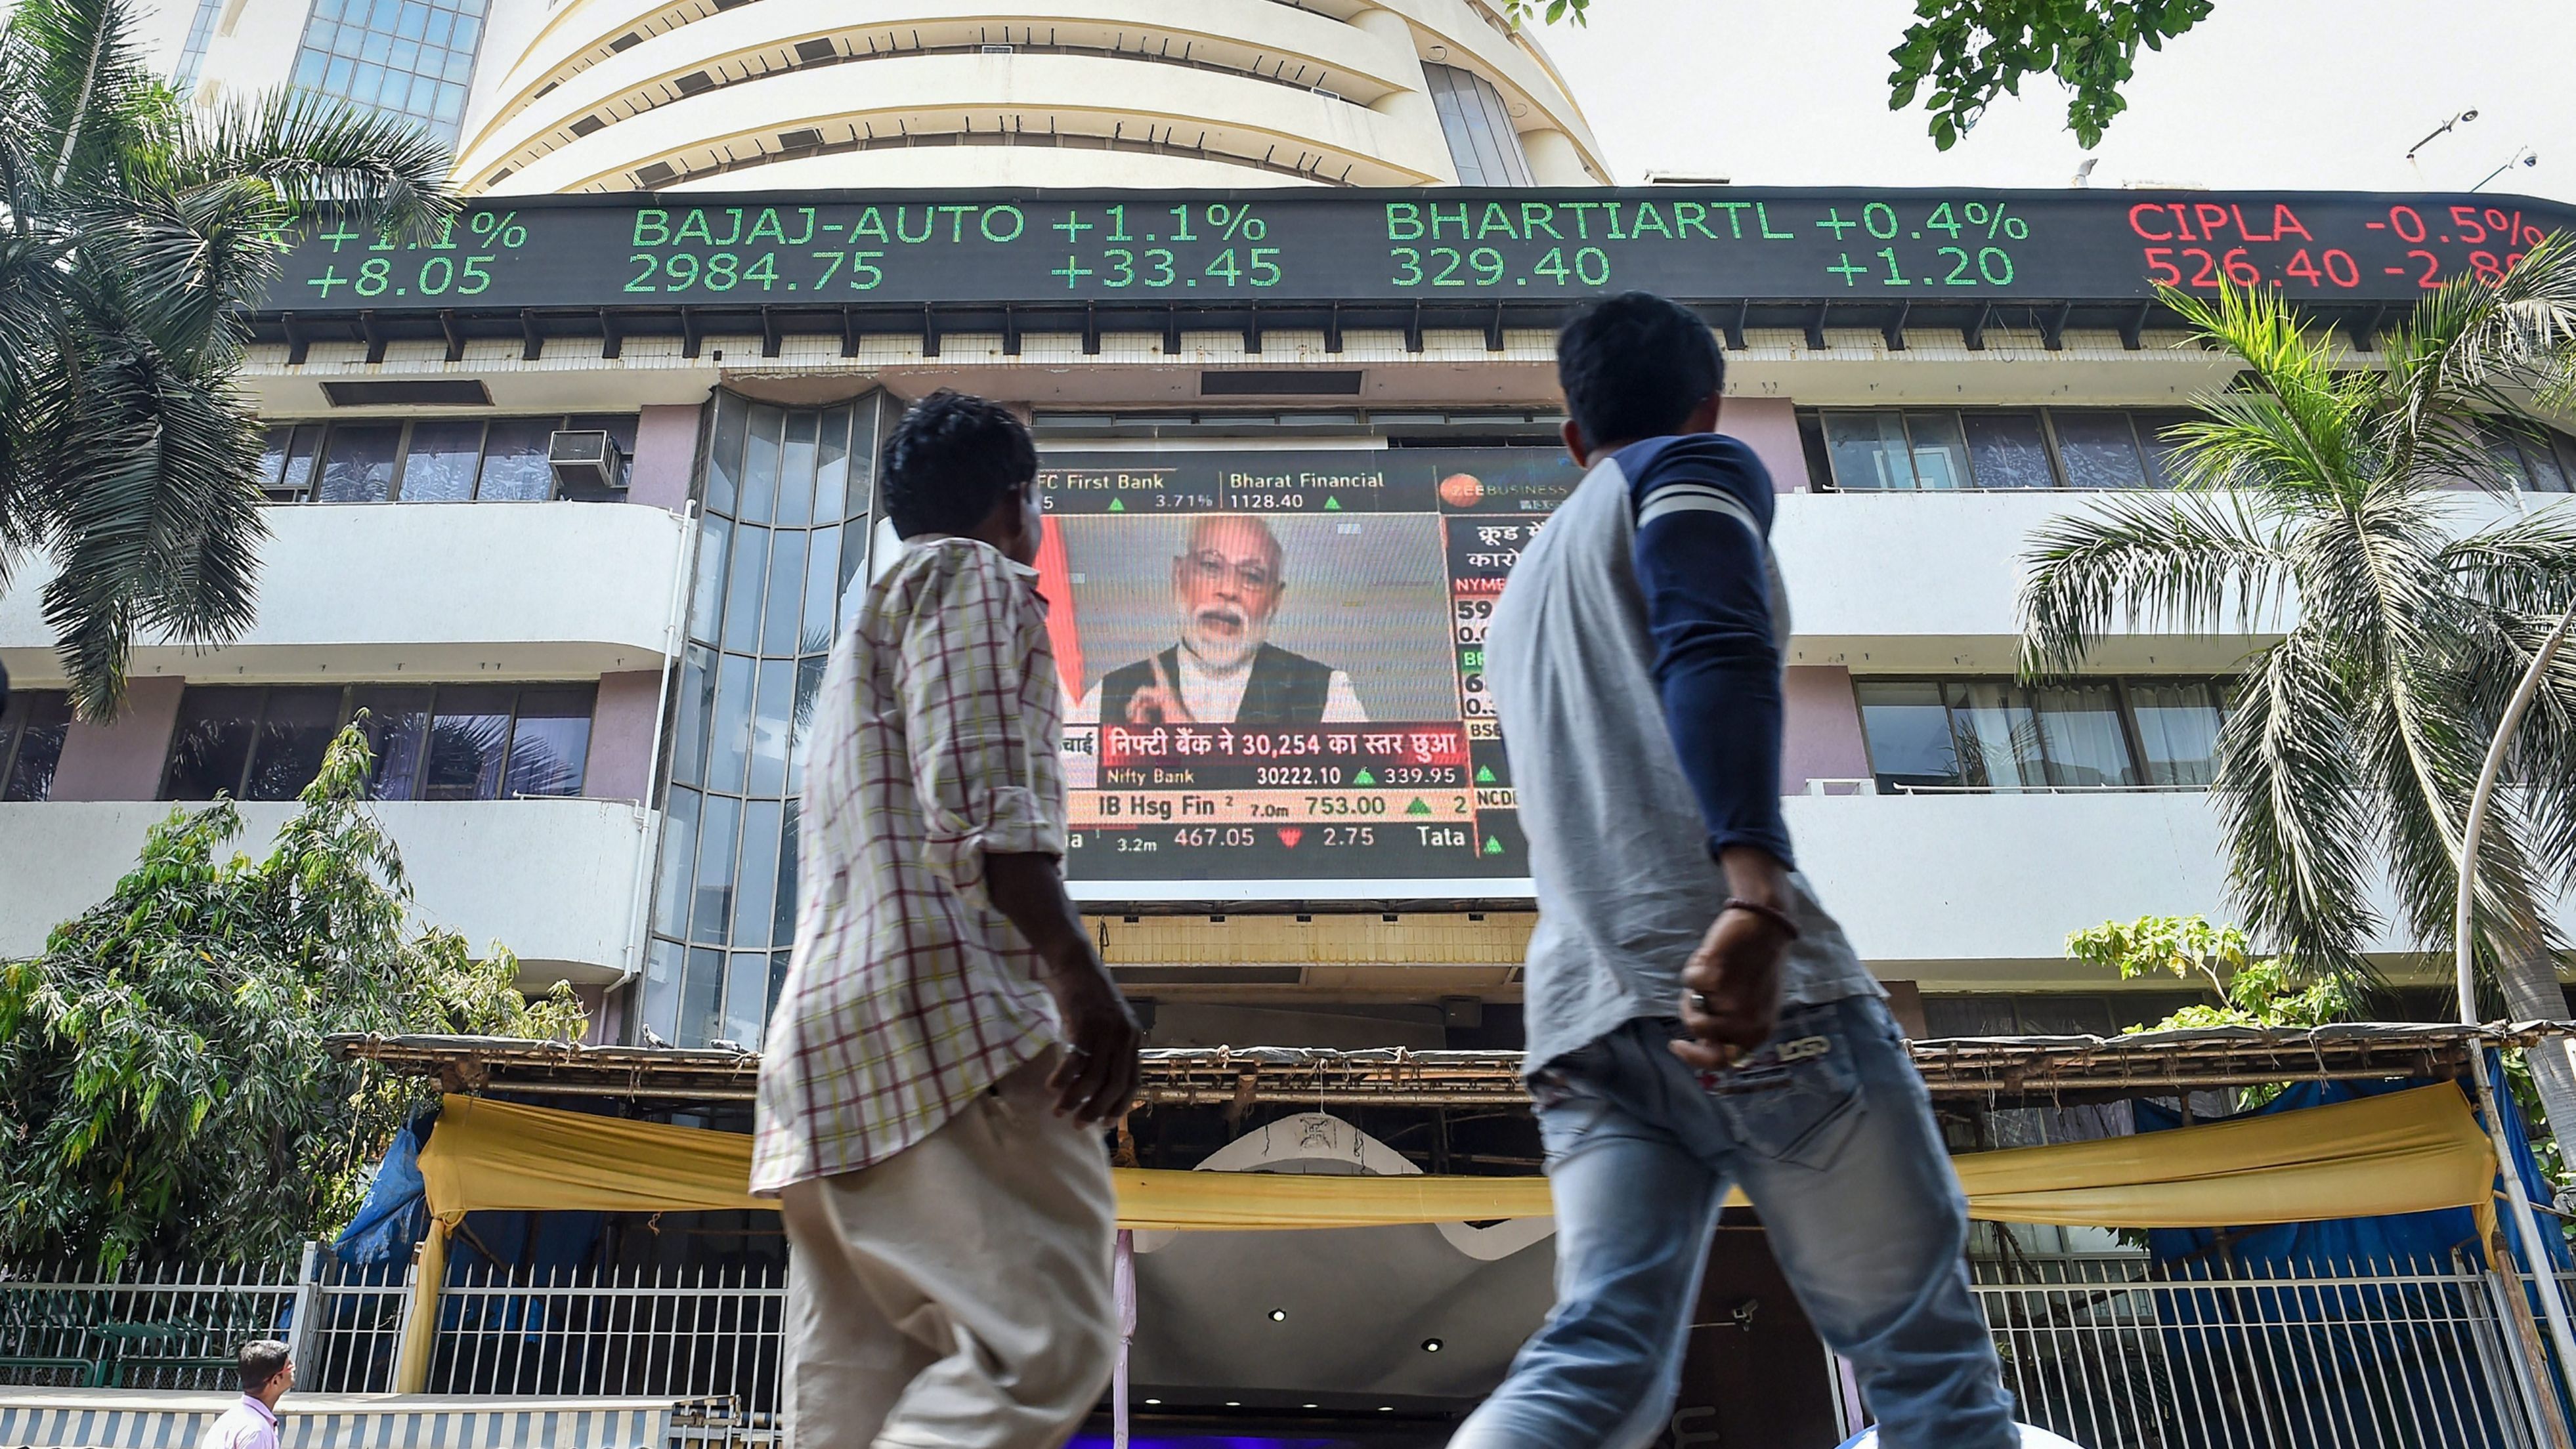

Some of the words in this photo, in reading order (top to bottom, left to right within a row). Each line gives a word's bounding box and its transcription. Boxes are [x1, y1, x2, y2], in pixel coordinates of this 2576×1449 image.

[632, 205, 1024, 247] BAJAJ-AUTO
[1052, 204, 1267, 243] +1.1%
[1386, 201, 1794, 240] BHARTIARTL
[1816, 202, 2029, 240] +0.4%
[2129, 203, 2312, 242] CIPLA
[2366, 205, 2544, 246] -0.5%
[307, 255, 495, 297] +8.05
[624, 251, 884, 292] 2984.75
[1051, 247, 1281, 289] +33.45
[1390, 247, 1610, 286] 329.40
[1826, 246, 2014, 285] +1.20
[2144, 247, 2360, 287] 526.40
[1067, 474, 1109, 489] First
[1118, 473, 1163, 489] Bank
[1230, 472, 1291, 488] Bharat
[1300, 472, 1384, 488] Financial
[1155, 494, 1213, 507] 3.71%
[1231, 494, 1303, 509] 1128.40
[1060, 732, 1093, 755] चाई
[1218, 726, 1234, 755] ने
[1242, 734, 1321, 758] 30,254
[1327, 734, 1358, 754] का
[1107, 768, 1146, 786] Nifty
[1154, 768, 1194, 784] Bank
[1257, 766, 1341, 785] 30222.10
[1385, 768, 1455, 784] 339.95
[1100, 796, 1121, 815] IB
[1130, 796, 1171, 821] Hsg
[1182, 795, 1214, 815] Fin
[1304, 795, 1386, 815] 753.00
[1117, 838, 1157, 852] 3.2m
[1174, 828, 1255, 847] 467.05
[1323, 827, 1374, 846] 2.75
[1416, 826, 1465, 846] Tata
